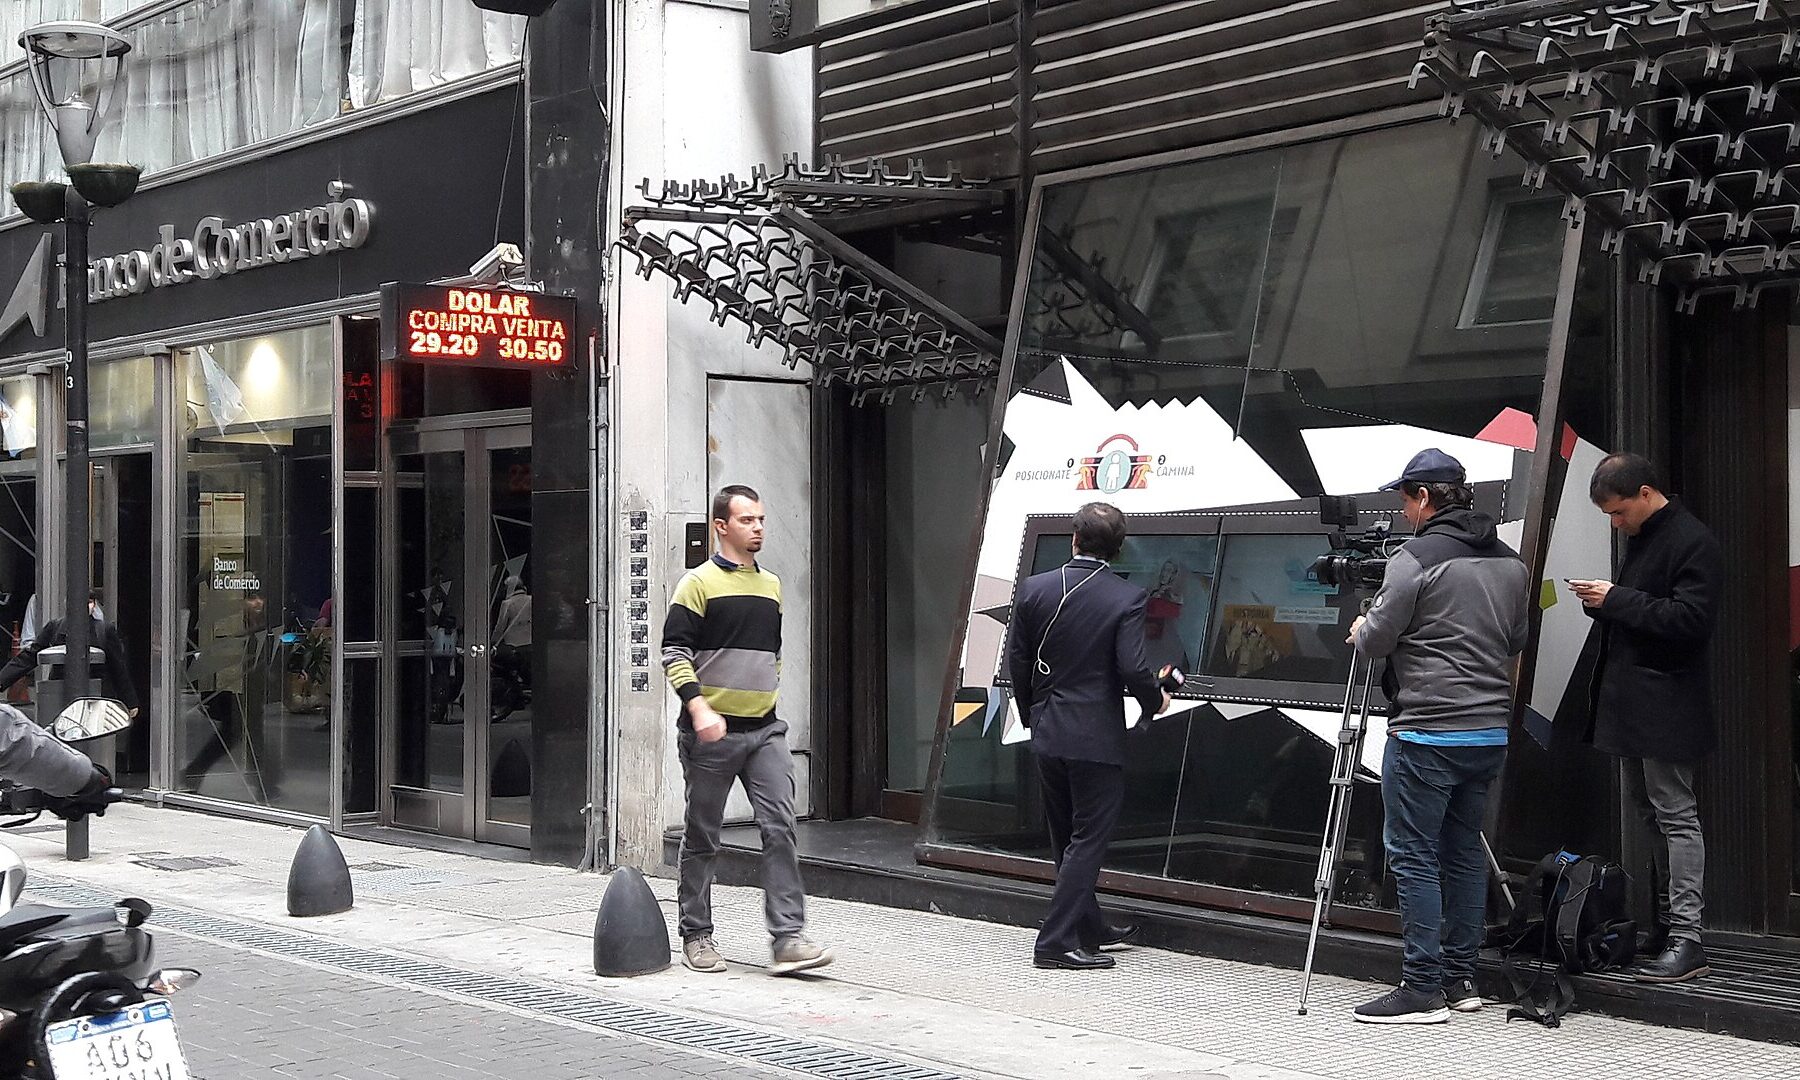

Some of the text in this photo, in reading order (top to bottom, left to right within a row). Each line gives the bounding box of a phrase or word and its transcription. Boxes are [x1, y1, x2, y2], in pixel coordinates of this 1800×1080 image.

[150, 224, 193, 288] de
[193, 181, 370, 280] Comercio
[448, 290, 530, 317] DOLAR
[409, 310, 566, 340] COMPRA VENTA
[410, 331, 563, 361] 29.20 30.50
[1015, 469, 1071, 481] POSICIONATE
[1156, 465, 1195, 477] CAMINA
[213, 557, 237, 572] Banco
[213, 575, 260, 590] de Comercio
